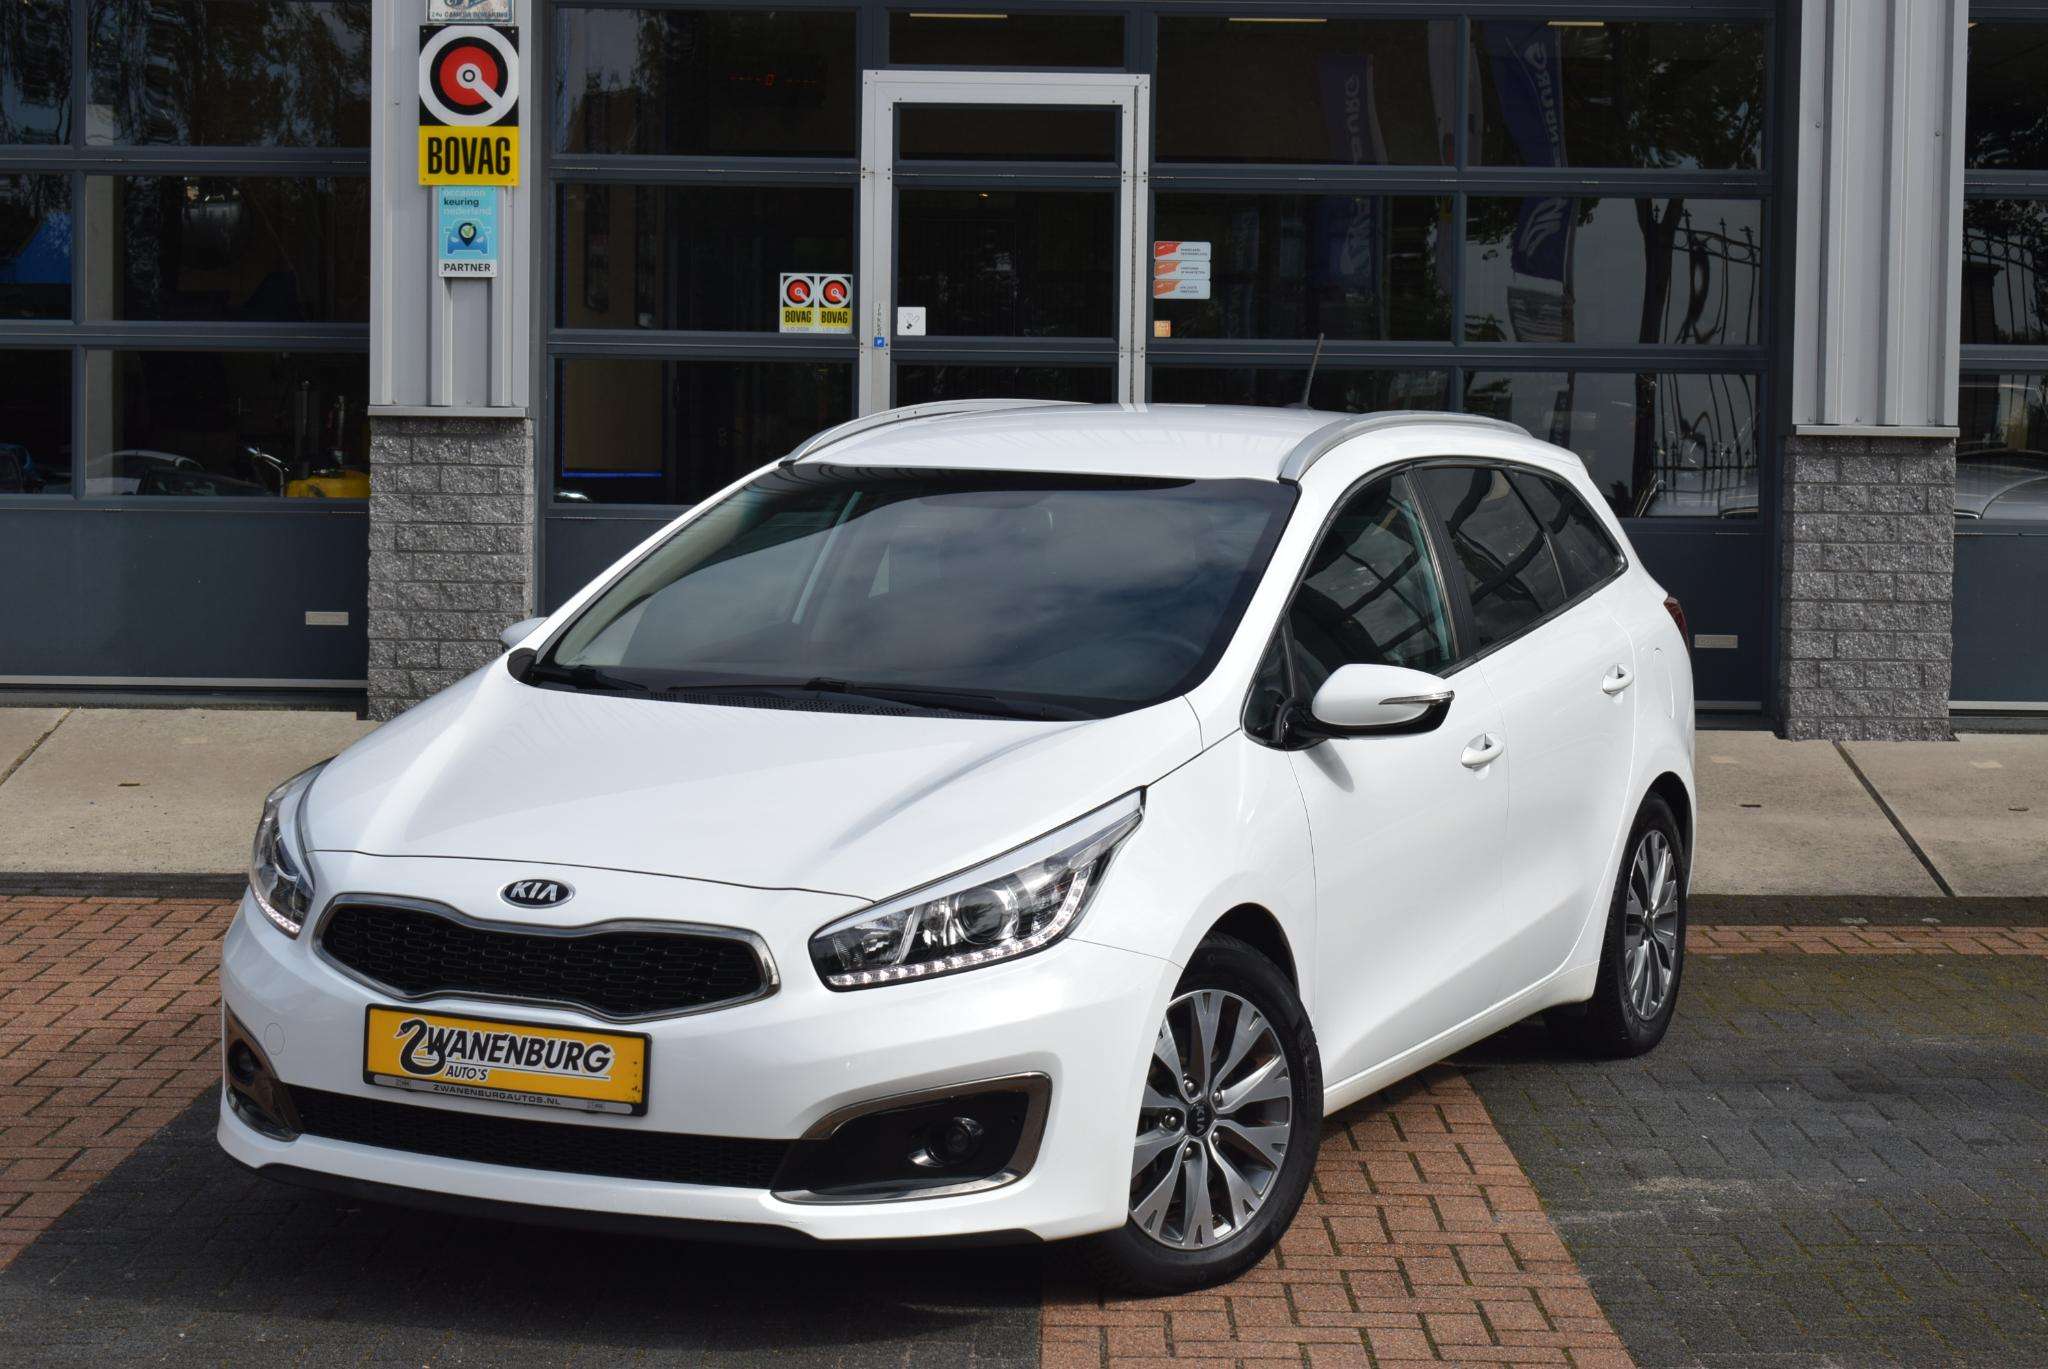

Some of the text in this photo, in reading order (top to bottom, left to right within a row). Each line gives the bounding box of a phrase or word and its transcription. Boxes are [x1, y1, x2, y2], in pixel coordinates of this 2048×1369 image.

[427, 136, 511, 176] BOVAG
[443, 197, 480, 208] keuring
[443, 263, 492, 272] PARTNER
[784, 310, 812, 324] BOVAG
[821, 311, 848, 324] BOVAG
[509, 881, 559, 902] KIA
[445, 1066, 488, 1081] AUTO'S
[432, 1083, 561, 1106] ZWANENBURGAUTOS.NL
